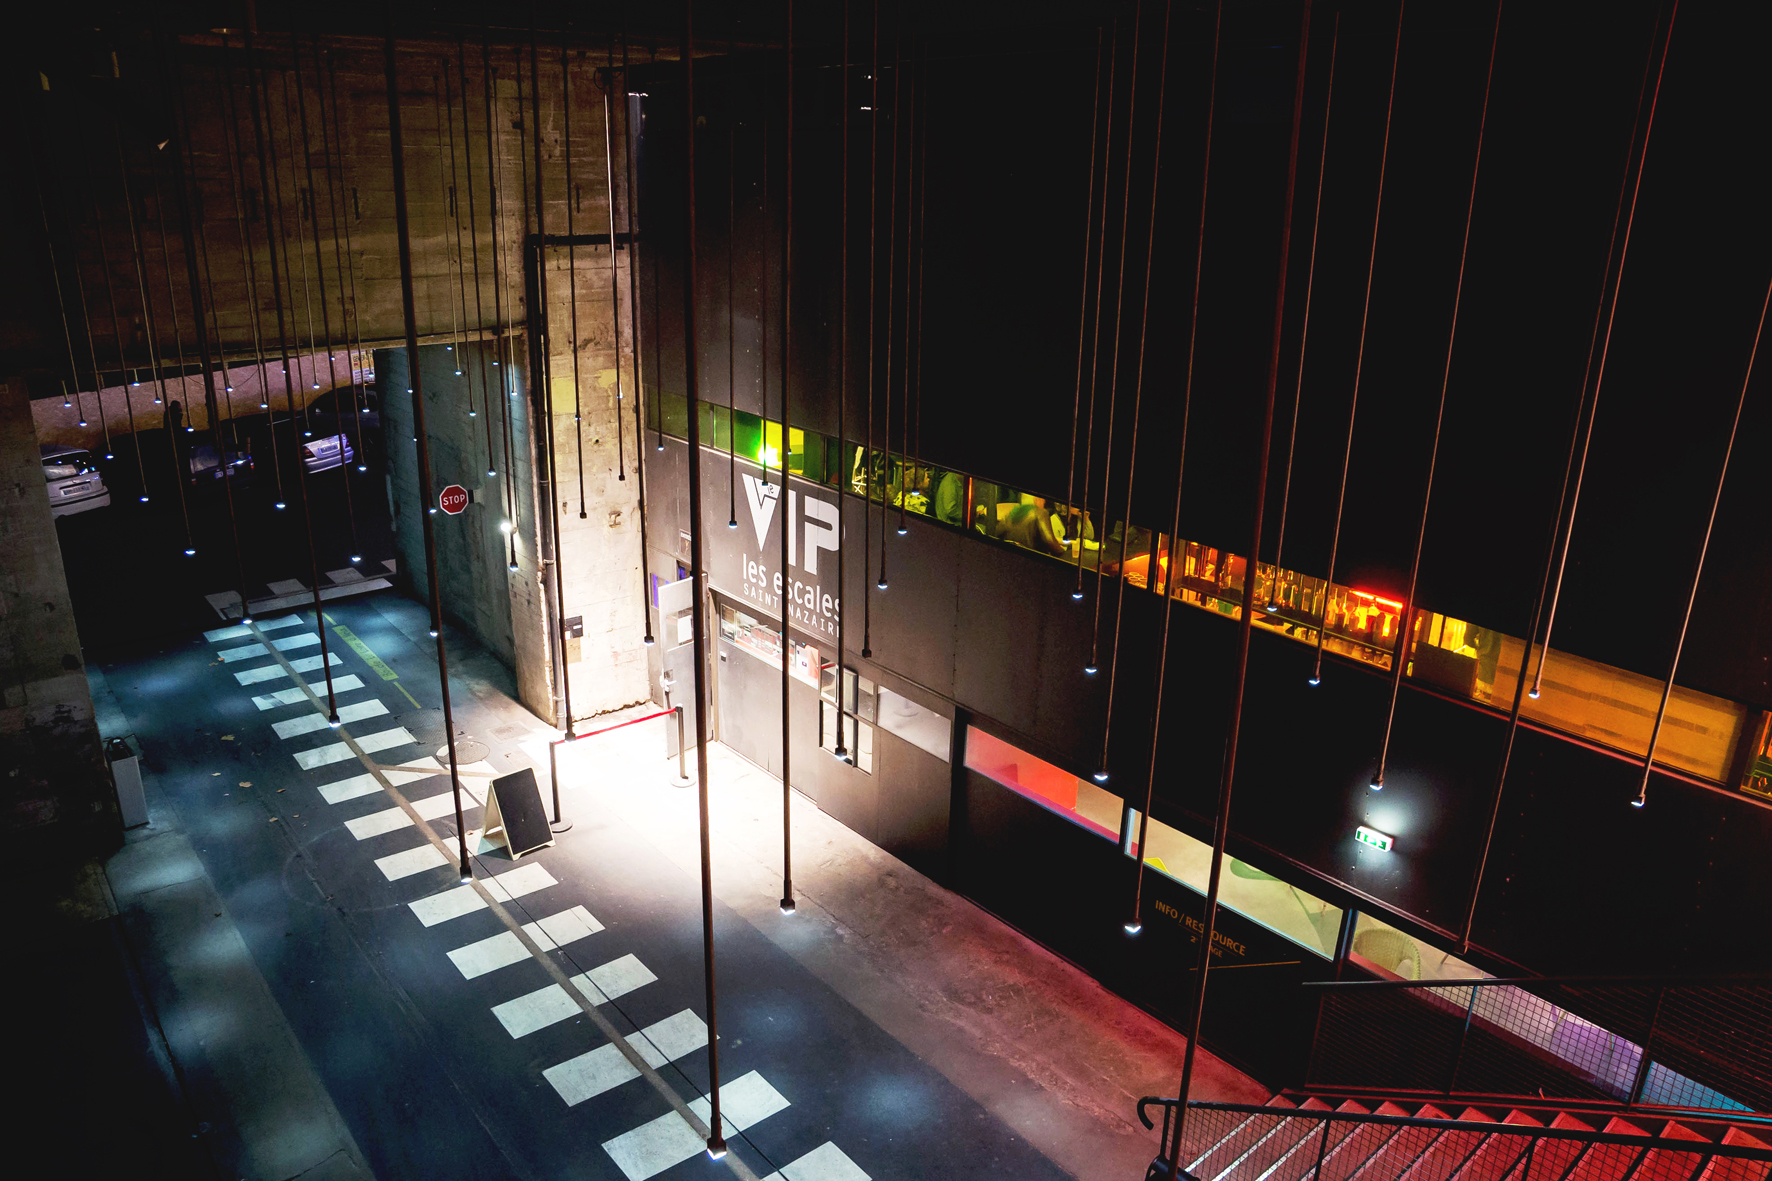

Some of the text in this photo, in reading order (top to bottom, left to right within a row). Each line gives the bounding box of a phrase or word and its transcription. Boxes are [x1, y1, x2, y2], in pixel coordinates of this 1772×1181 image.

[443, 494, 466, 506] STOP
[742, 473, 845, 576] VIP
[742, 553, 767, 588] les
[743, 583, 779, 609] SAINT
[1155, 899, 1178, 919] INFO
[1185, 915, 1246, 957] RESOURCE
